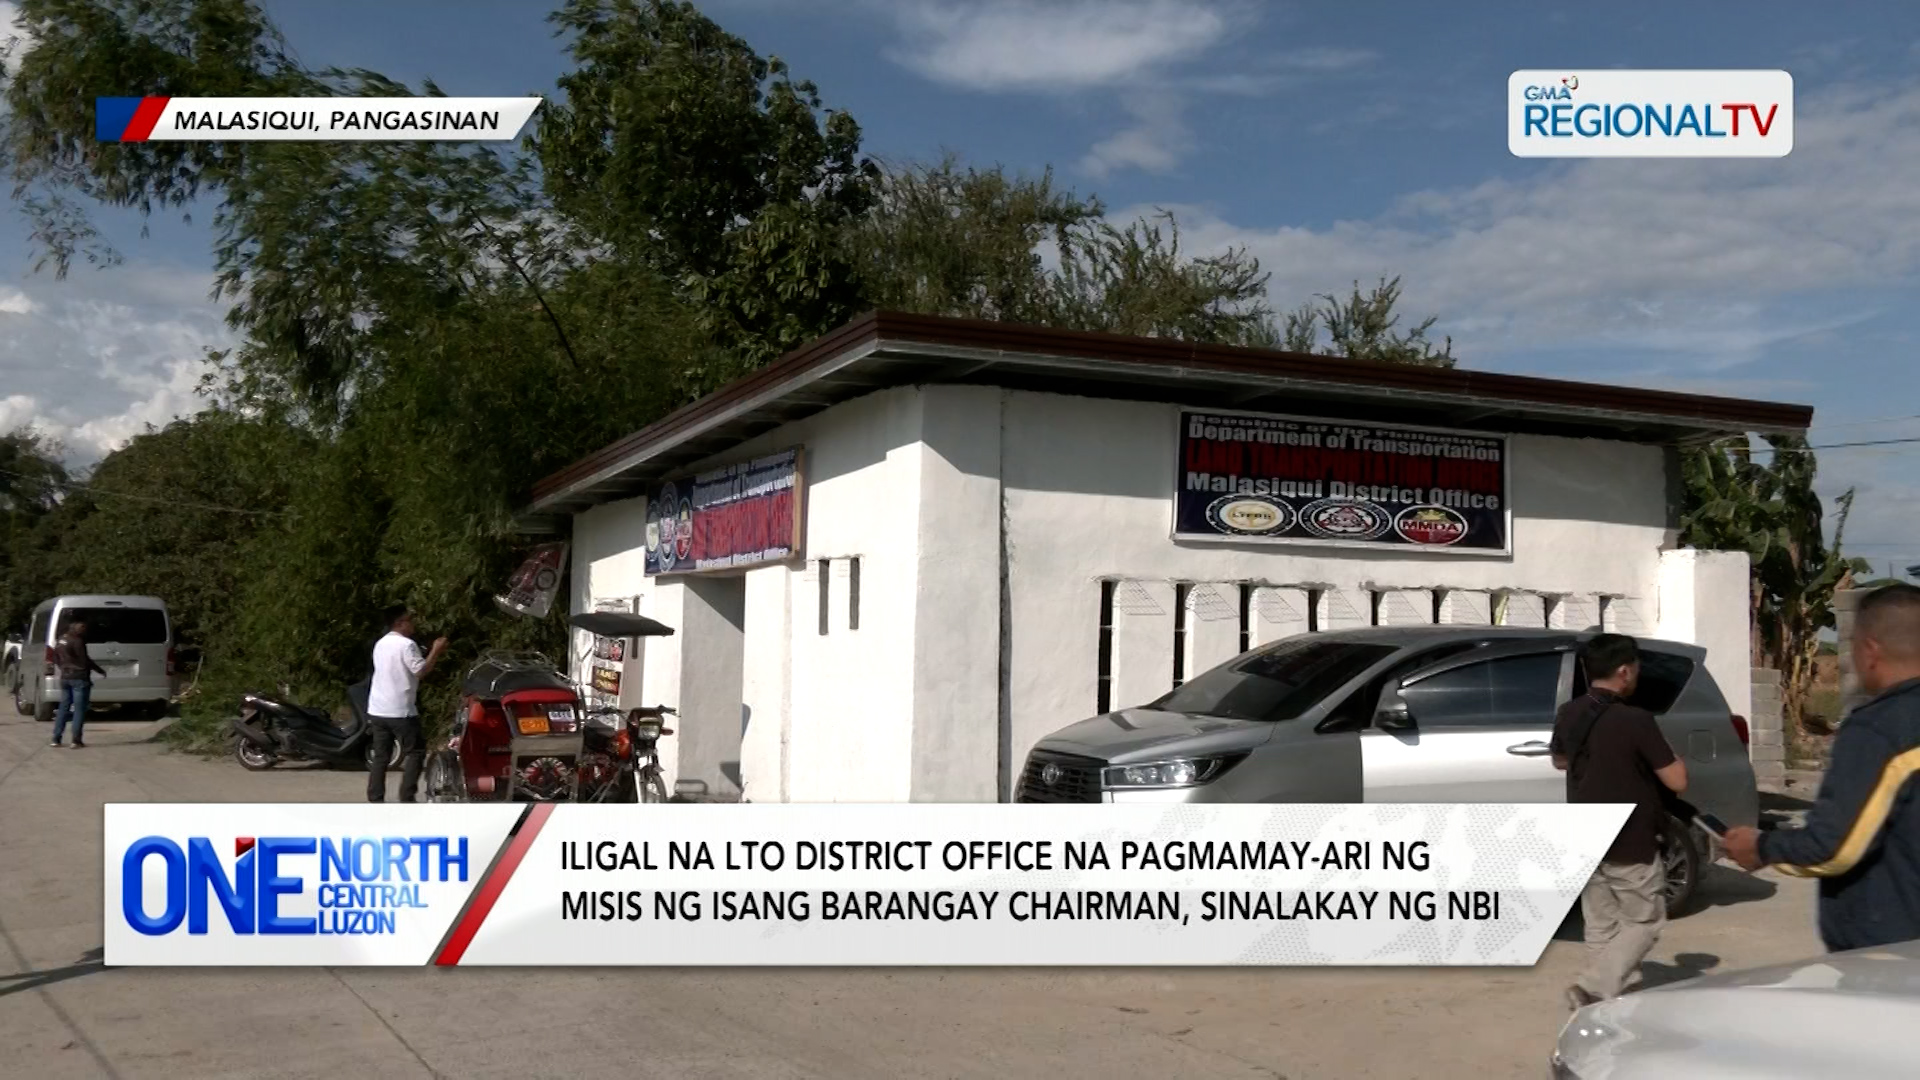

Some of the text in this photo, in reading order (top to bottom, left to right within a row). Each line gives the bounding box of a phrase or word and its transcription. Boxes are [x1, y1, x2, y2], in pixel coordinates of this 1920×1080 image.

[1188, 422, 1501, 462] Department of Transportation
[1186, 471, 1500, 510] Malasiqui District Office
[1402, 520, 1459, 531] MMDA
